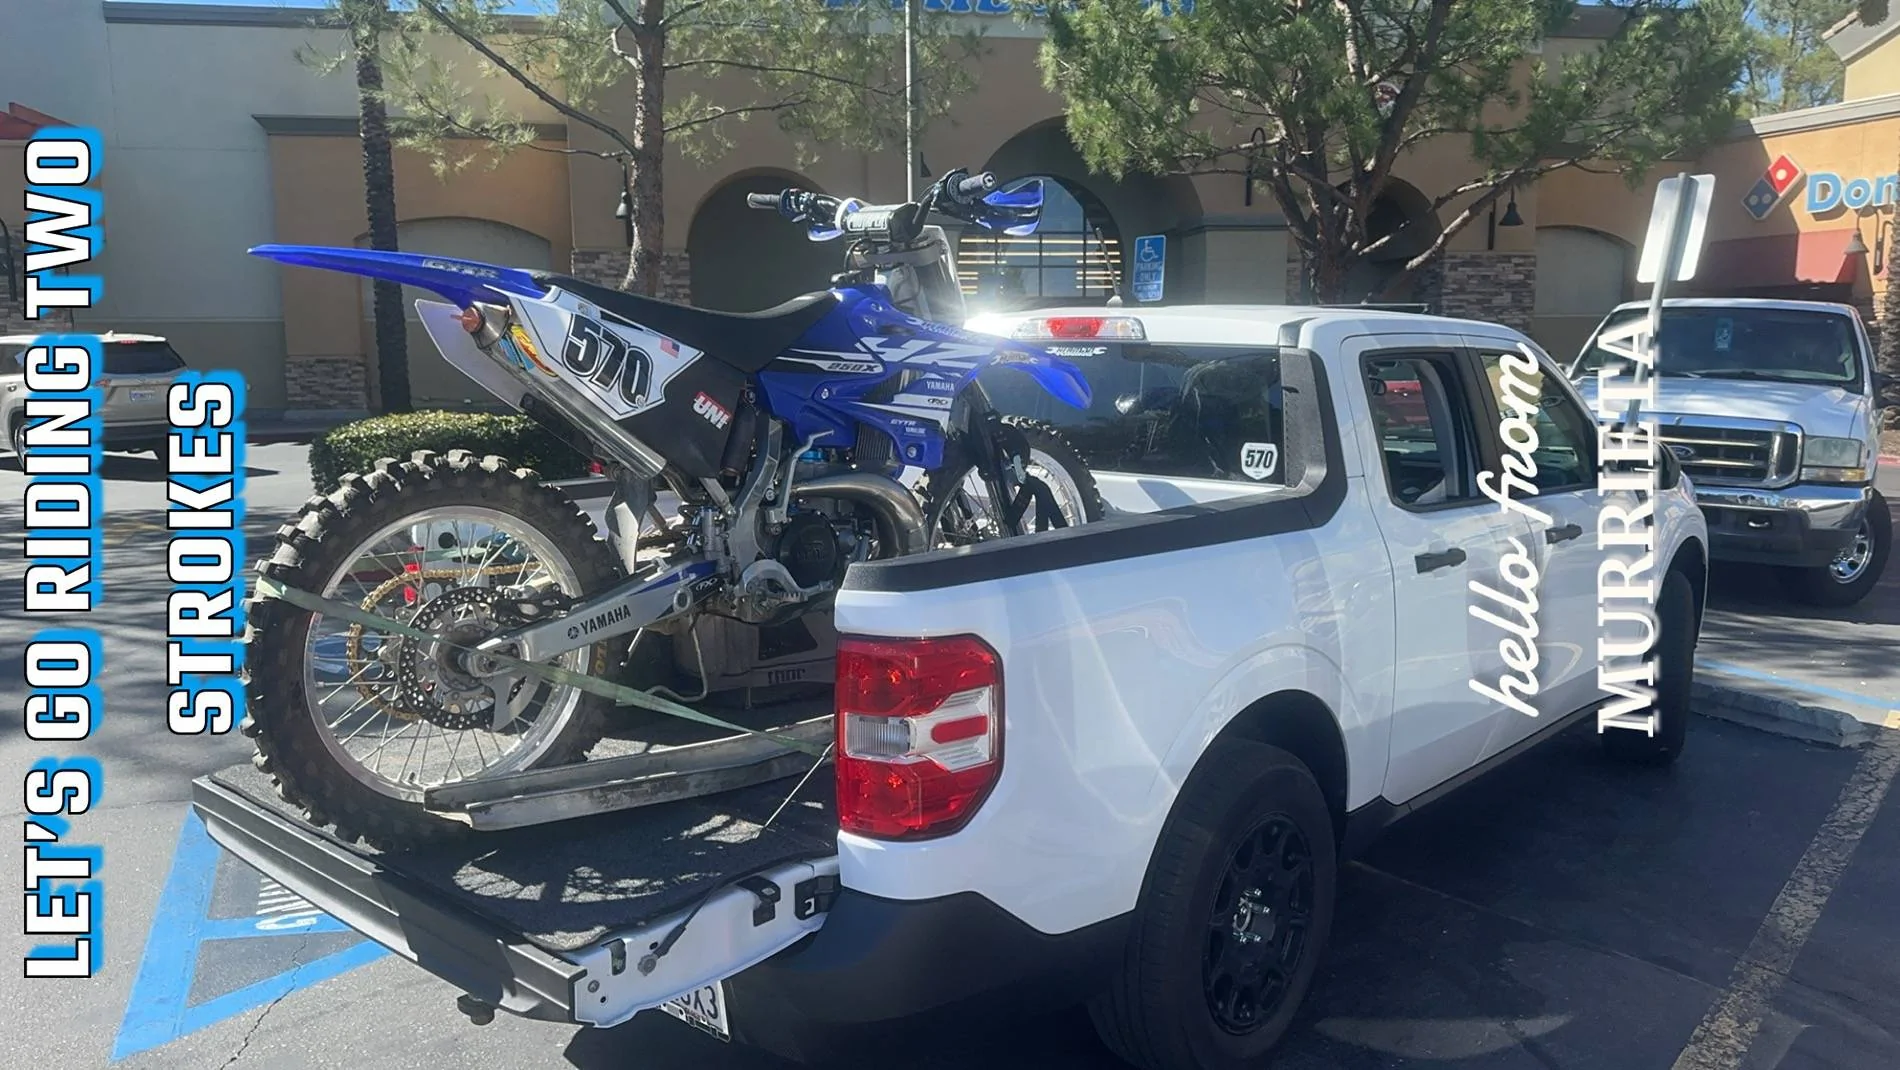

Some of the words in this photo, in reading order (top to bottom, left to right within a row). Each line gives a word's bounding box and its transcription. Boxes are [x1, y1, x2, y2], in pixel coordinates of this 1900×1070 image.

[561, 313, 654, 408] 570
[855, 336, 994, 369] YZ
[827, 362, 880, 372] 250X
[926, 381, 955, 392] YAMAHA
[1245, 449, 1274, 468] 570
[580, 604, 631, 635] YAMAHA
